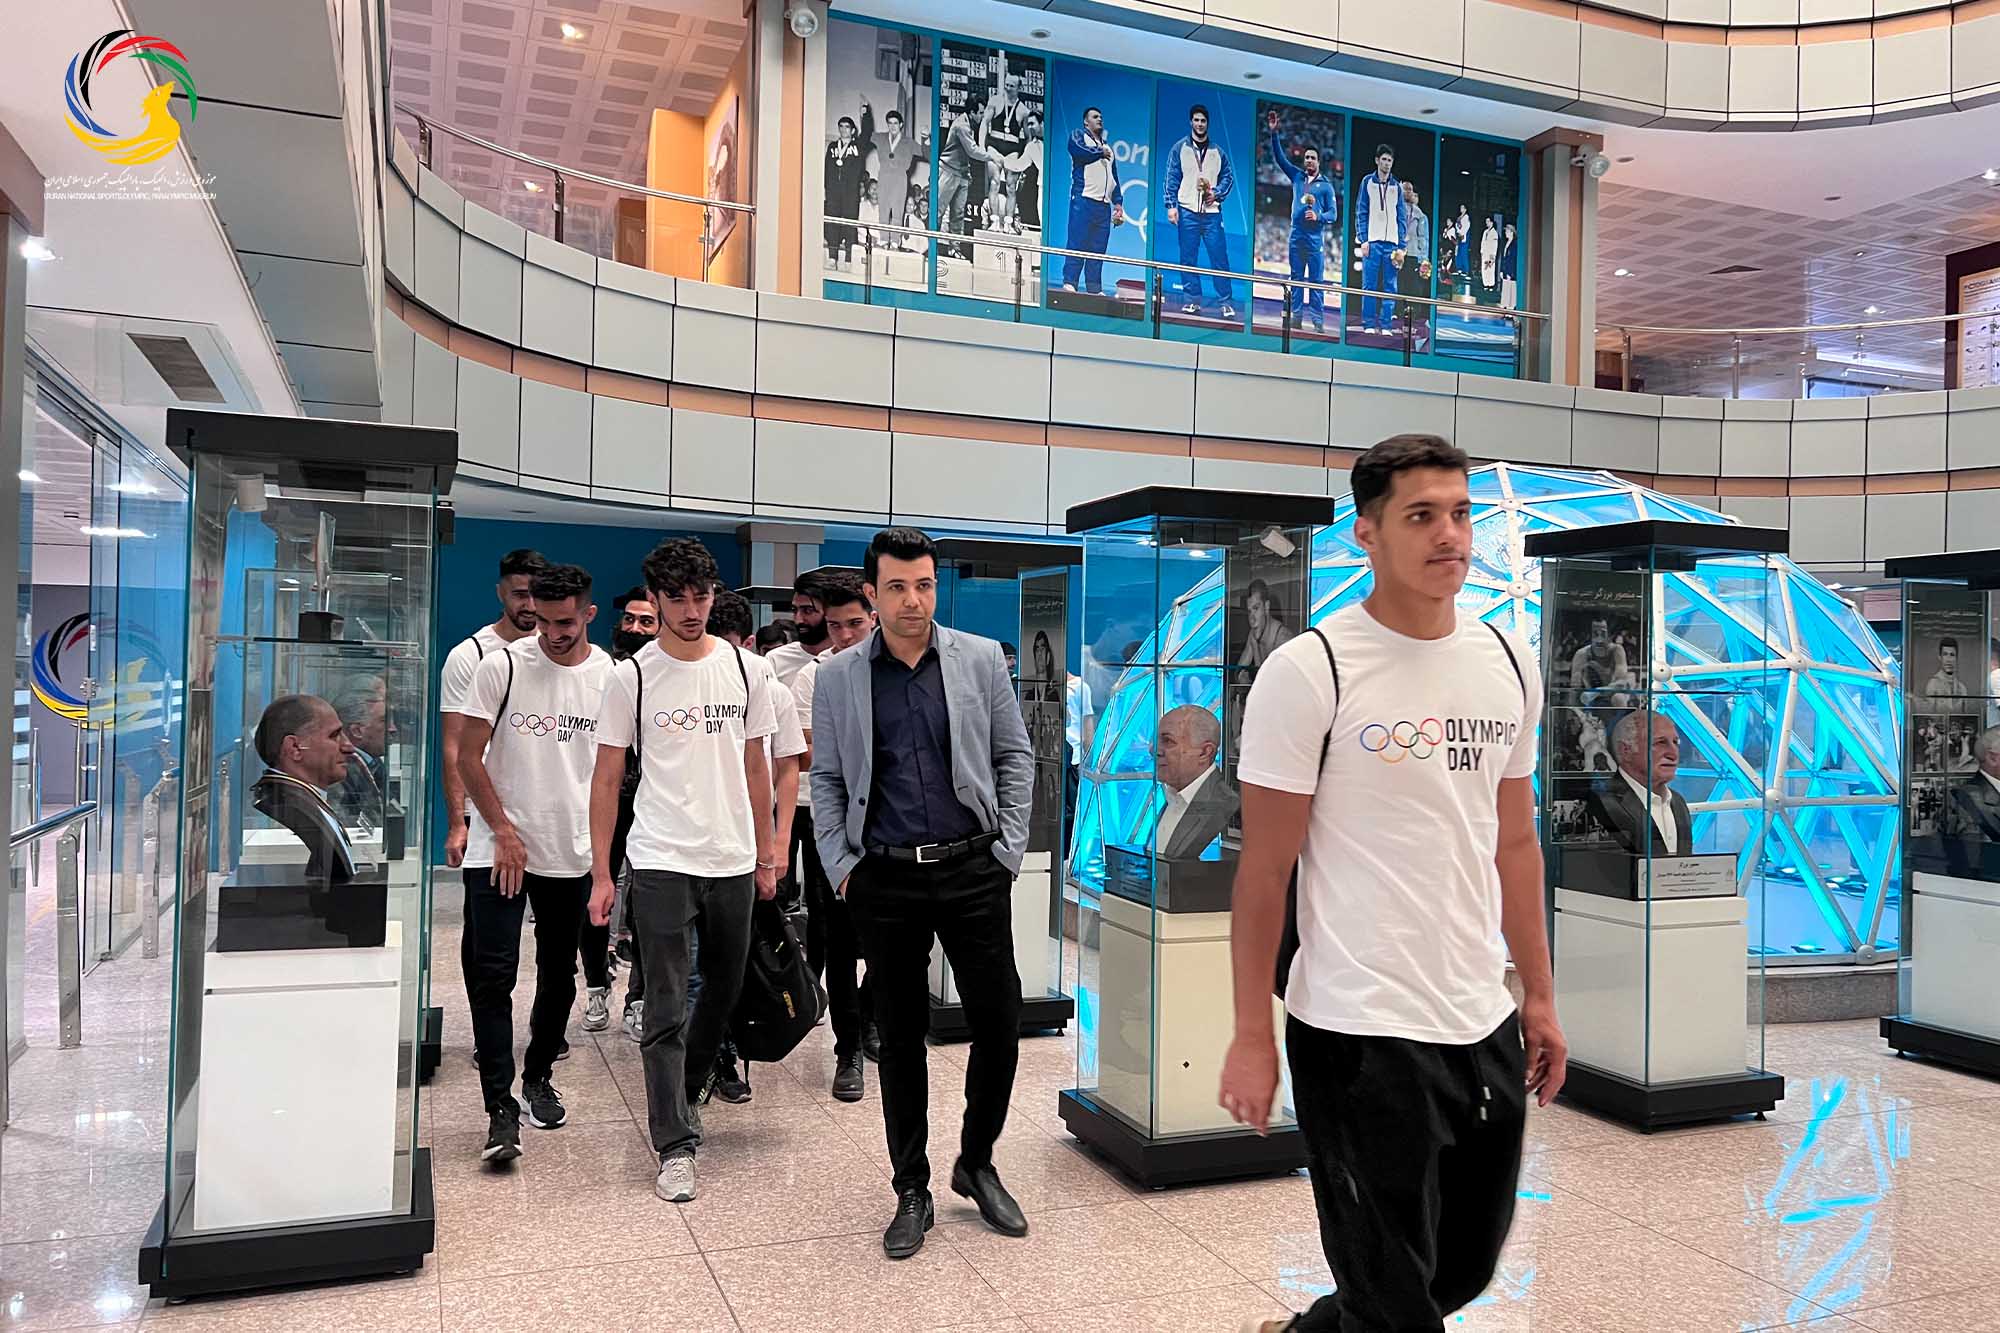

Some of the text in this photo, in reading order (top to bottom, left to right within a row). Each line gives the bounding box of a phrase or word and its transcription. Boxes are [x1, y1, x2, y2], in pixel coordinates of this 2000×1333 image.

[557, 729, 574, 743] DAY
[706, 719, 723, 734] DAY
[1446, 718, 1516, 746] OLYMPIC
[1447, 747, 1483, 771] DAY
